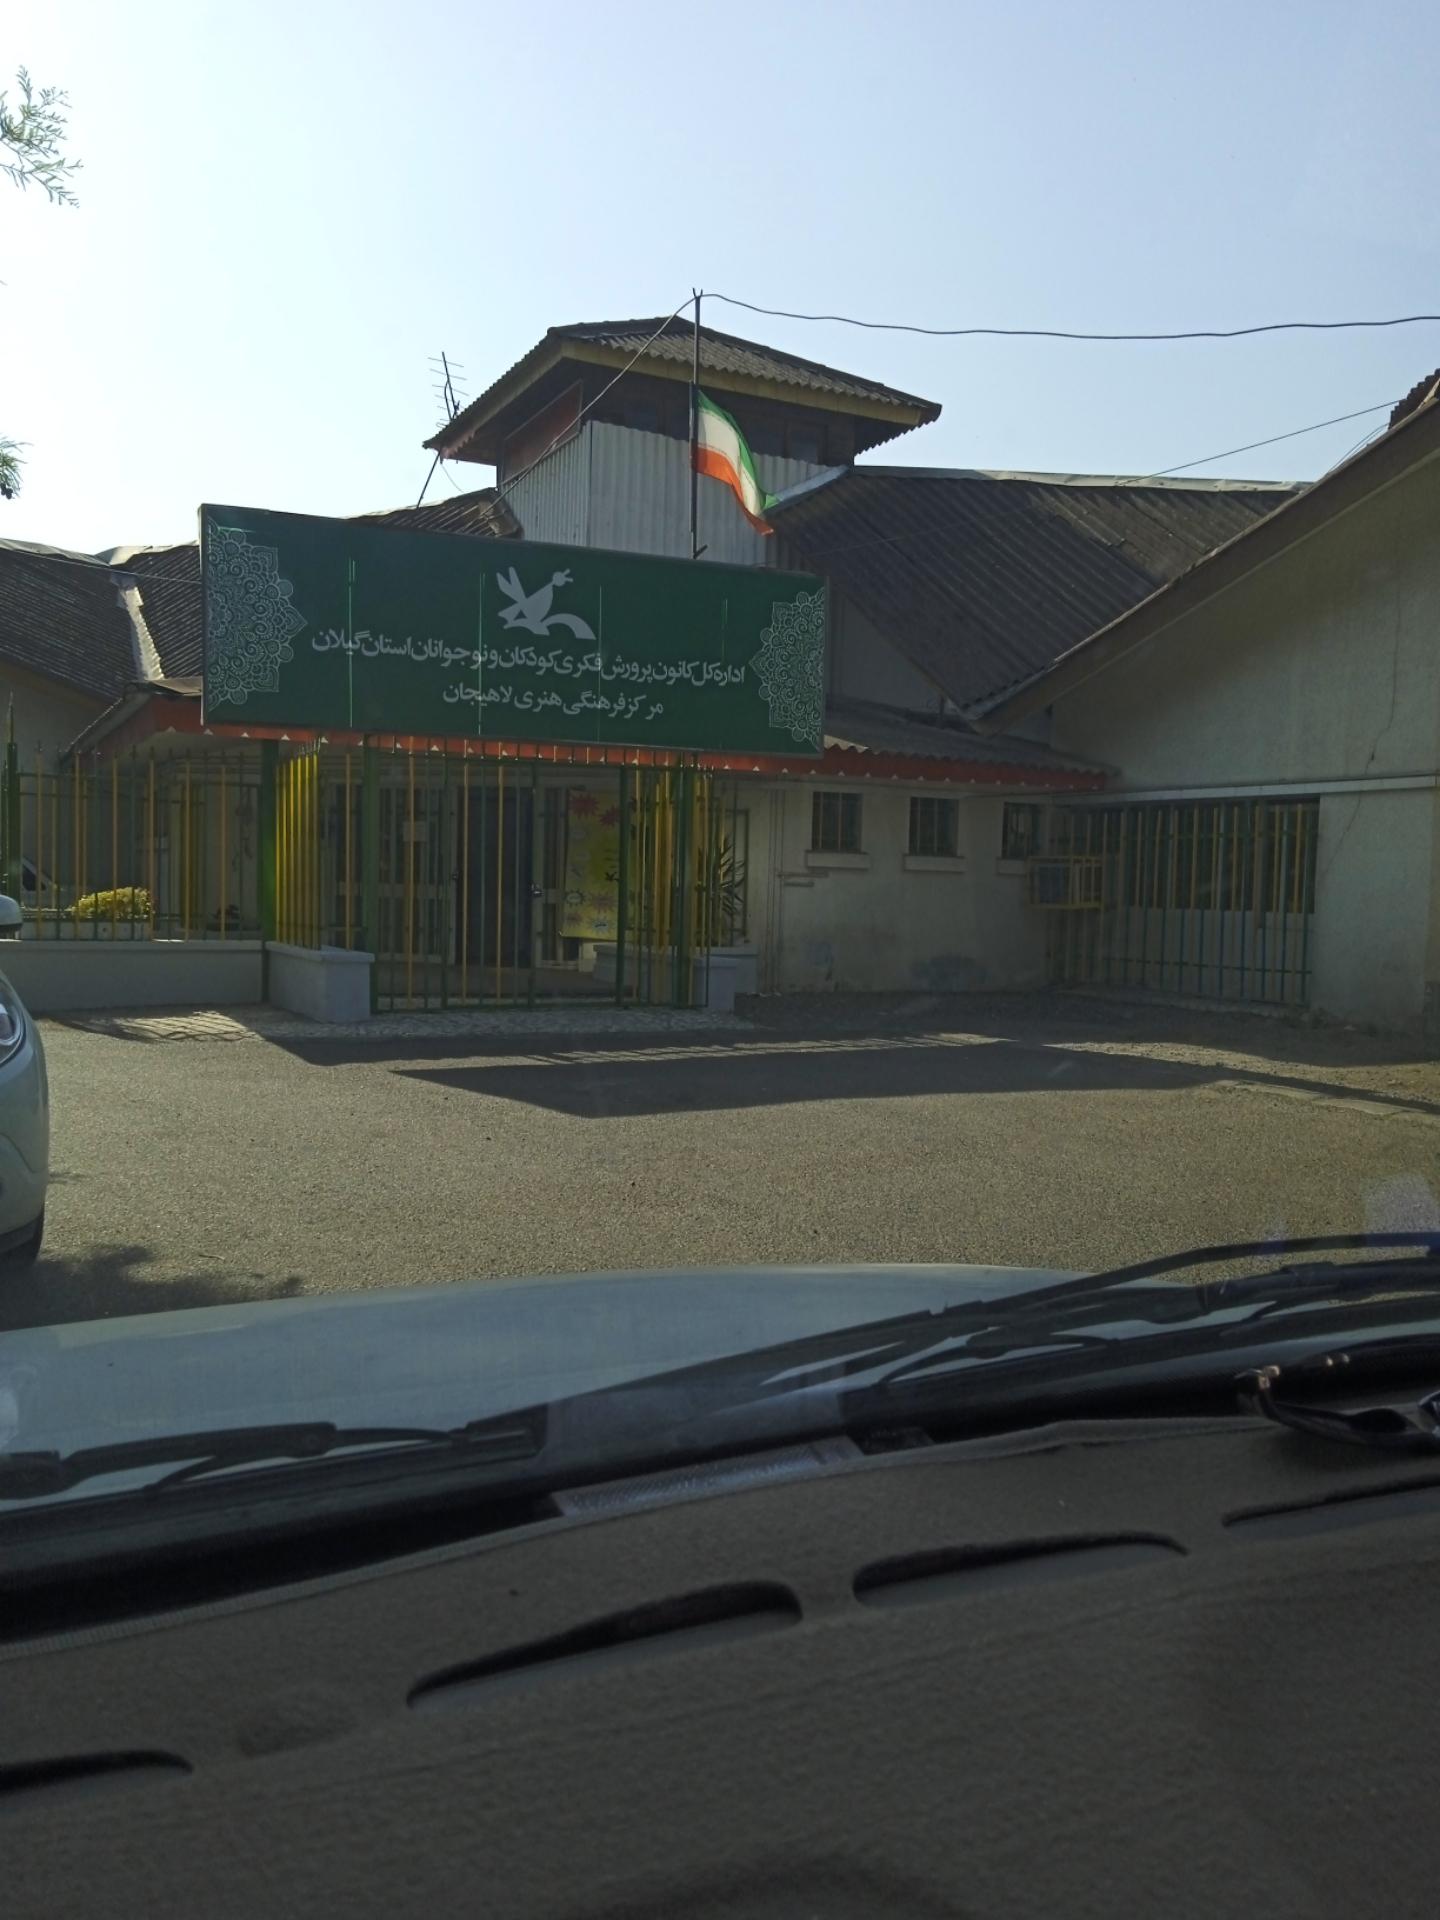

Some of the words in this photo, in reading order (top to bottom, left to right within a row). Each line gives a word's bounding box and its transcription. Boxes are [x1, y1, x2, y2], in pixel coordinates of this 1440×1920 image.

[312, 628, 371, 655] گیلان
[361, 634, 412, 657] استان
[499, 646, 562, 676] کودکان
[554, 652, 602, 678] فکری
[600, 655, 652, 683] پرورش
[652, 660, 700, 685] کانون
[691, 660, 721, 686] کل
[713, 664, 745, 686] اداره
[443, 682, 513, 707] لاهیجان
[514, 690, 562, 713] هنری
[562, 690, 626, 718] فرهنگی
[623, 694, 663, 720] مرکز
